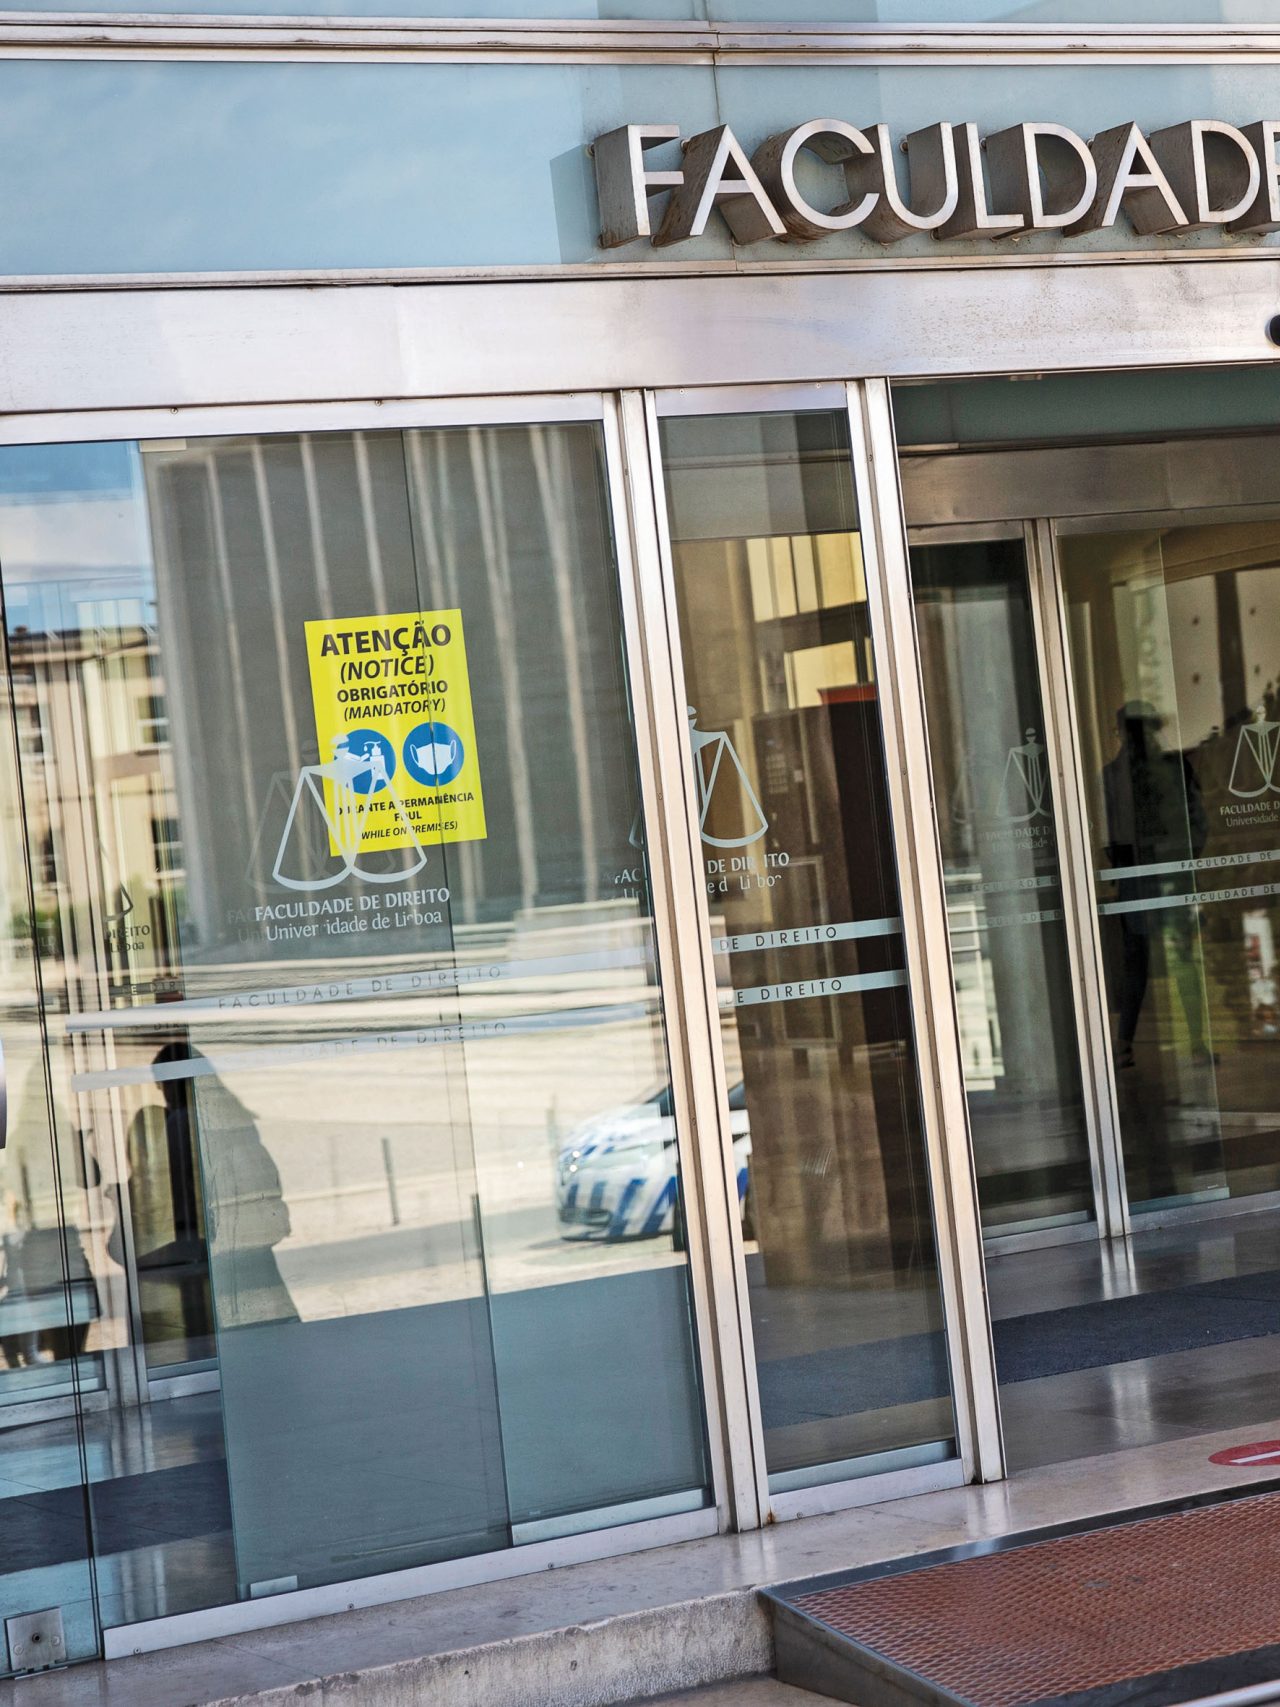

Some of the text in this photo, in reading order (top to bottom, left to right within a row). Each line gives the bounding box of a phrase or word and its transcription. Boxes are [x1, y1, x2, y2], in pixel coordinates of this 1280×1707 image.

[320, 620, 452, 657] ATENÇÃO
[340, 654, 435, 684] (NOTICE)
[336, 679, 448, 703] OBRIGATÓRIO
[344, 698, 446, 722] (MANDATORY)
[388, 801, 396, 810] A
[1219, 801, 1272, 816] FACULDADE
[1226, 813, 1279, 828] Universidade
[361, 828, 391, 840] WHILE
[393, 826, 408, 836] ON
[708, 851, 790, 874] DE DIRITO
[1181, 854, 1251, 870] FACULDADE
[1259, 851, 1272, 861] DE
[739, 873, 782, 891] Libo
[254, 896, 354, 922] FACULDADE
[359, 893, 381, 911] DE
[385, 887, 450, 908] DIREITO
[1184, 887, 1255, 904] FACULDADE
[1263, 884, 1275, 894] DE
[266, 916, 368, 942] Univeridade
[372, 912, 391, 930] de
[720, 926, 837, 951] DE DIREITO
[218, 966, 502, 1009] FACULDADE DE DIREITO
[761, 979, 842, 1001] DIREITO
[416, 1022, 507, 1044] DIREITO
